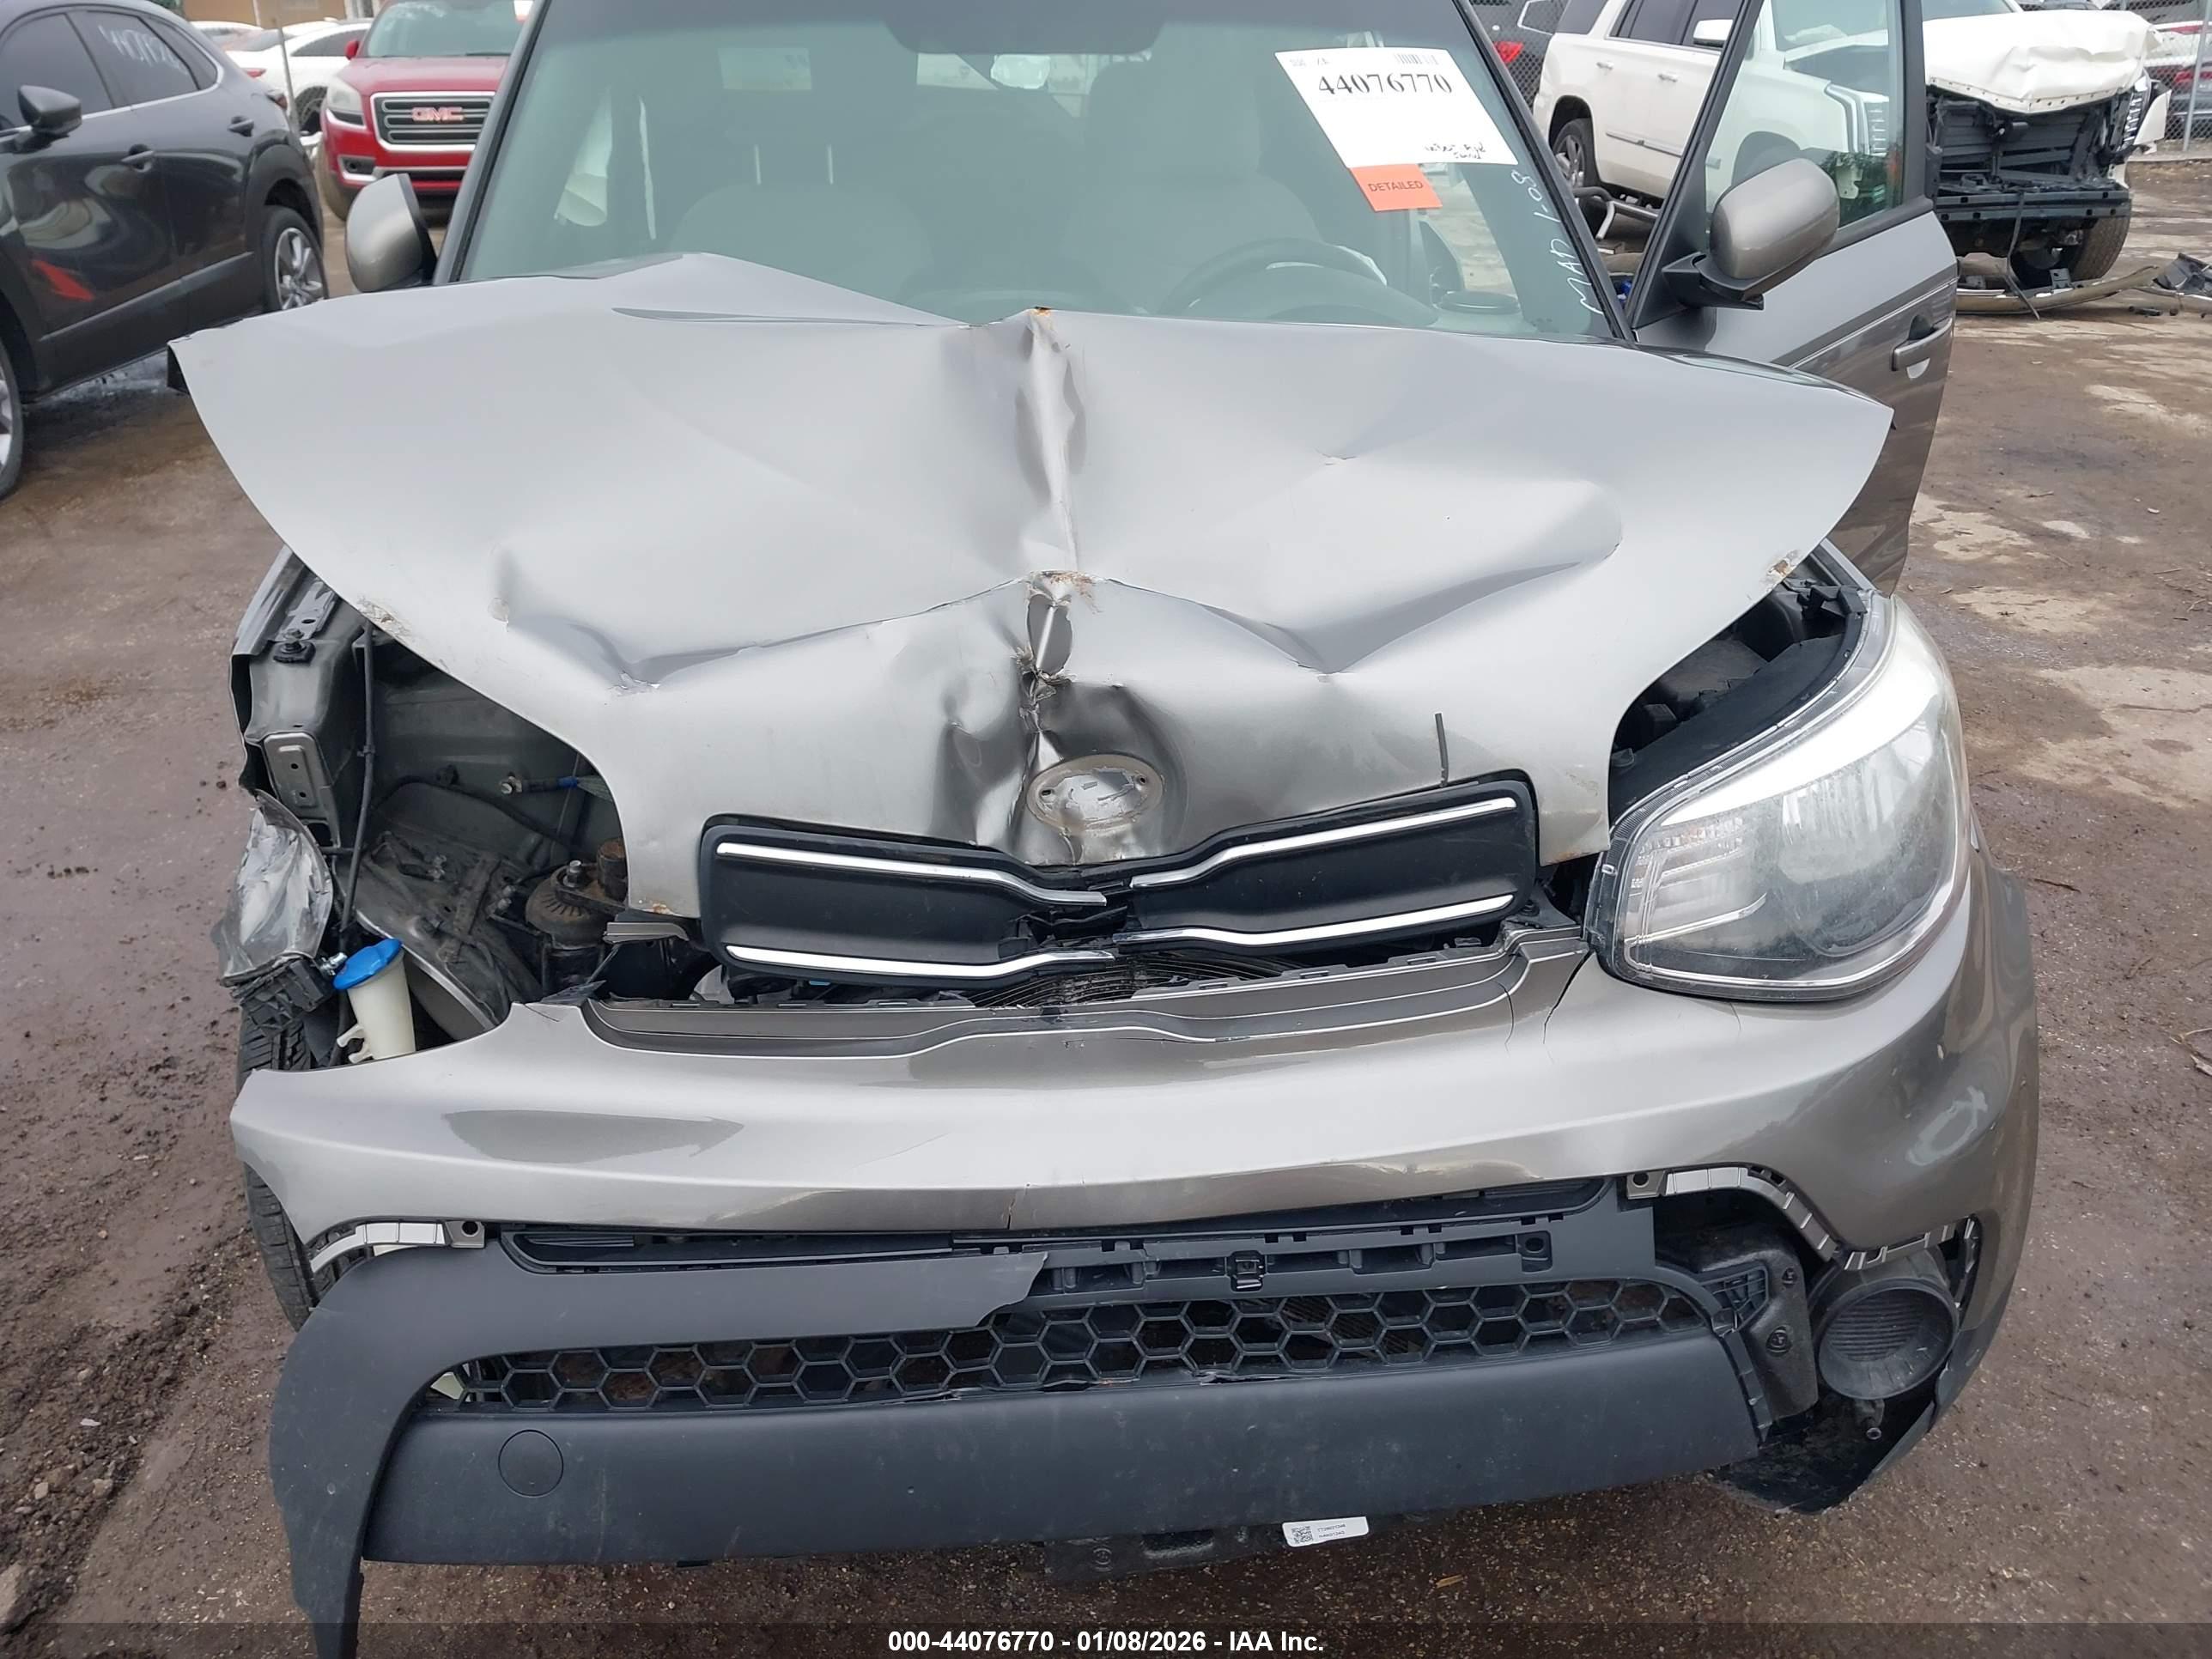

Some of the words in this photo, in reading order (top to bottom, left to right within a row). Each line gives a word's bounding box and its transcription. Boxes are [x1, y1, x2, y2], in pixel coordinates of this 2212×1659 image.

[1319, 73, 1452, 94] 44076770
[412, 106, 465, 122] GMC
[1368, 180, 1424, 191] DETAILED
